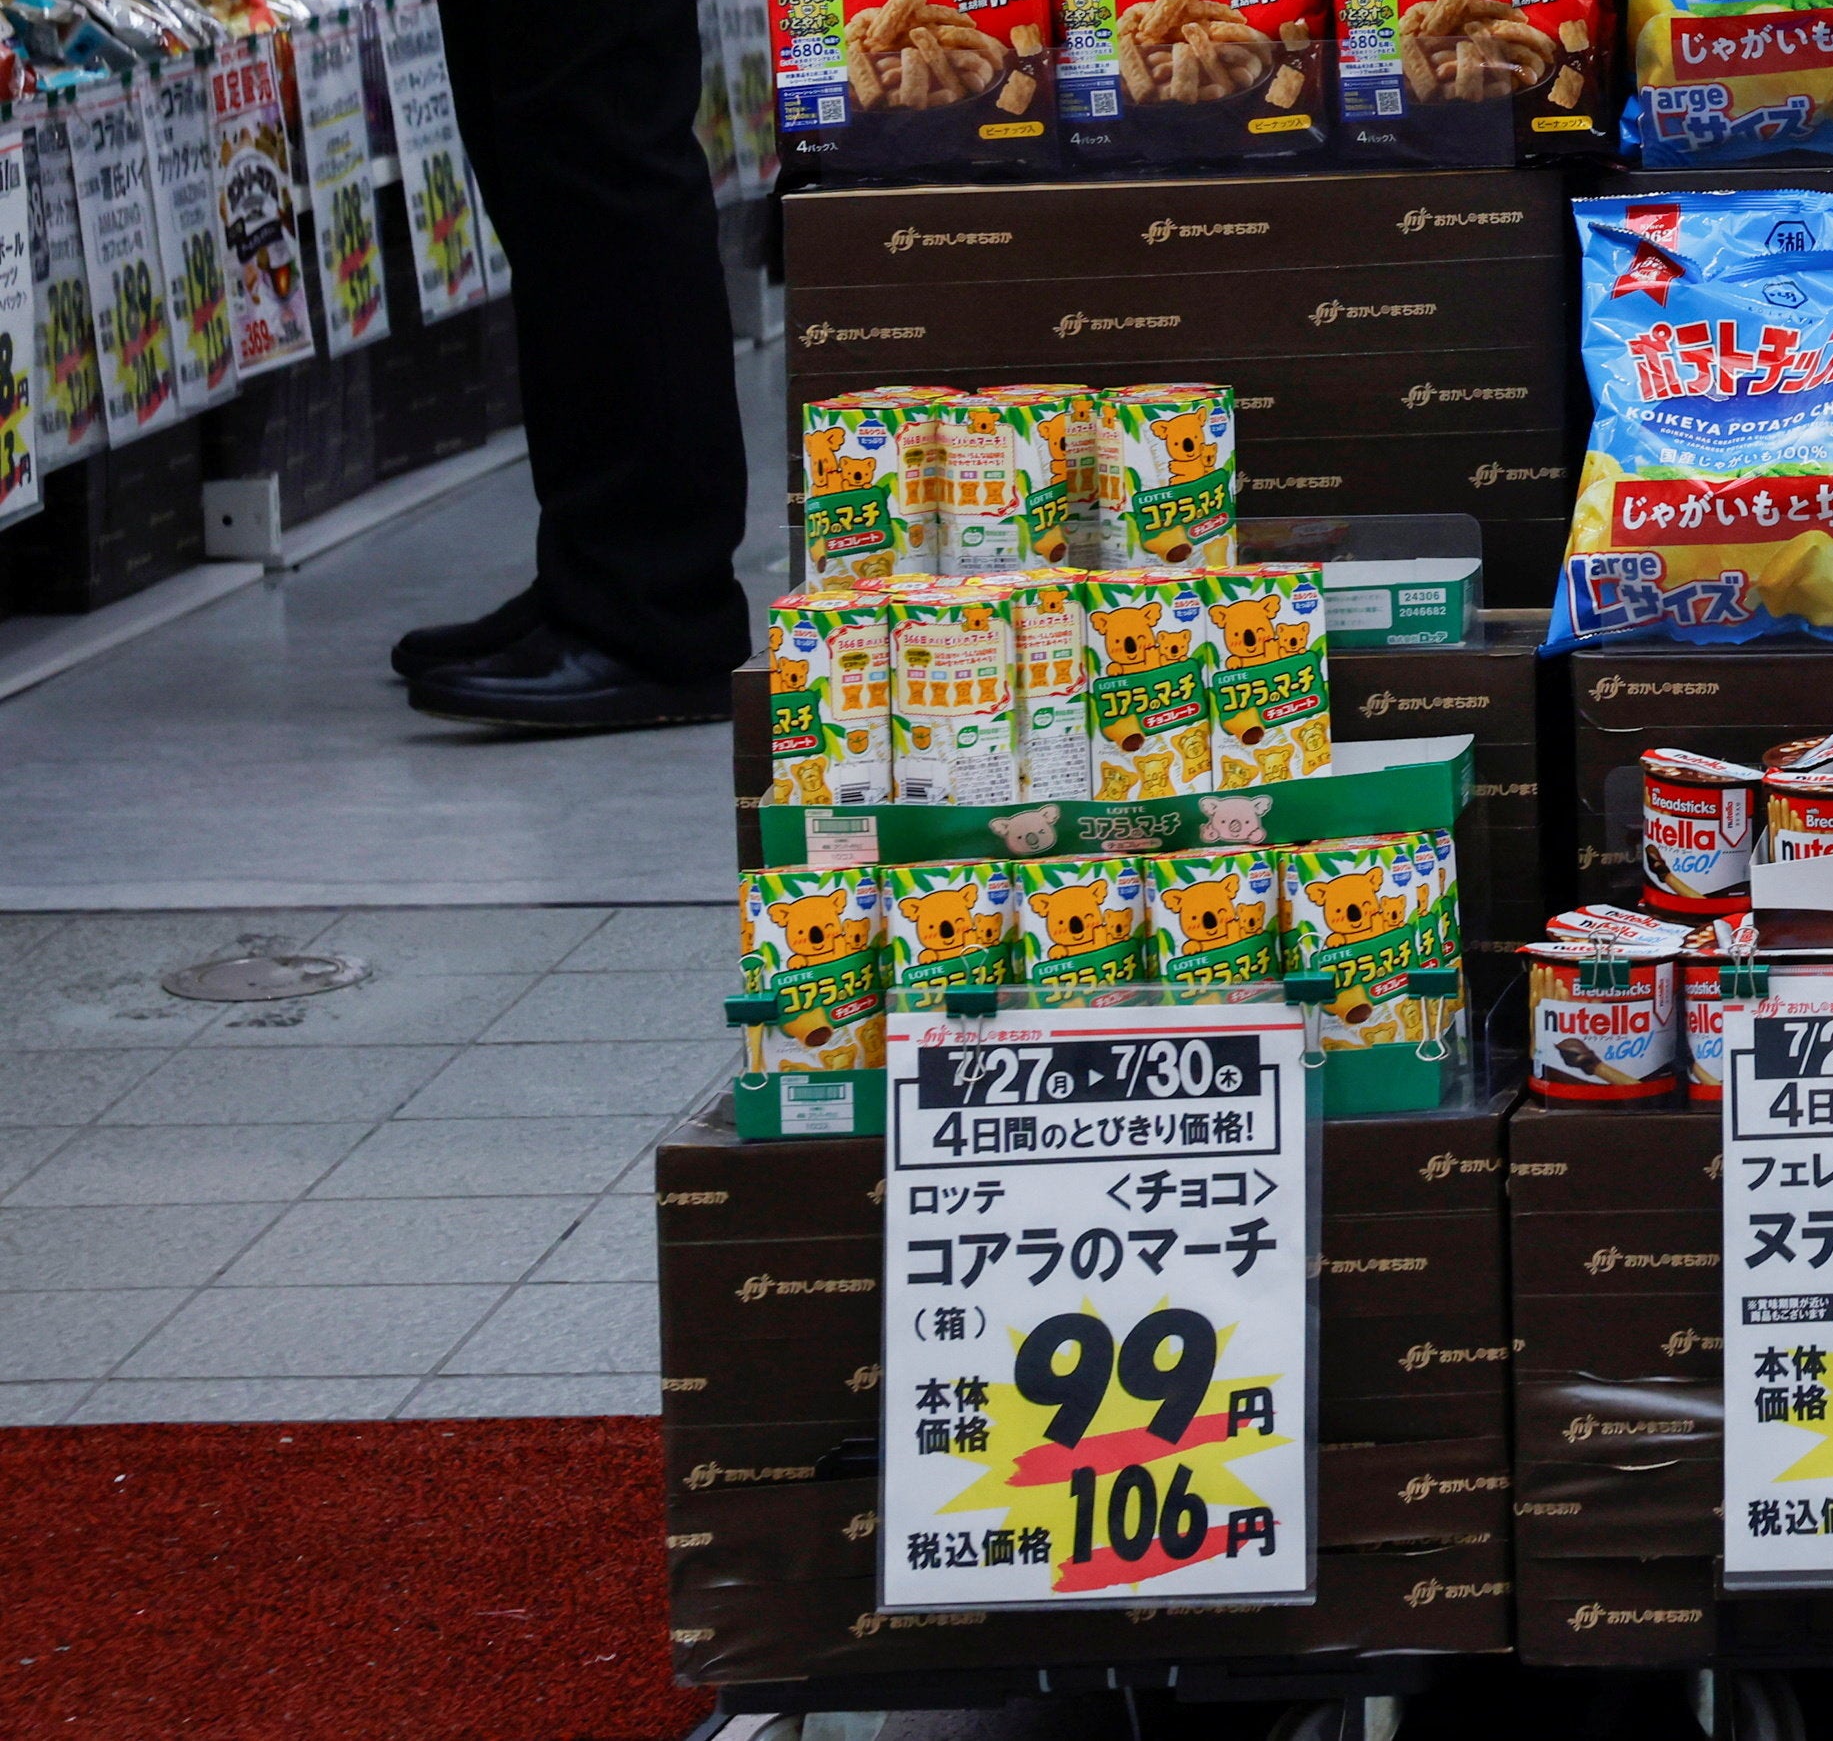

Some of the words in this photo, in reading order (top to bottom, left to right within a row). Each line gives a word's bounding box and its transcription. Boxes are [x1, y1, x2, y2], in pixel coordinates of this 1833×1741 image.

[1139, 493, 1174, 504] LOTTE
[1399, 606, 1448, 617] 2046682
[1403, 590, 1441, 602] 24306
[1100, 672, 1197, 717] コアラのマーチ
[933, 1111, 1253, 1156] 4日間のとびきり価格!
[909, 1181, 1005, 1214] ロッテ
[907, 1217, 1277, 1286] コアラのマーチ
